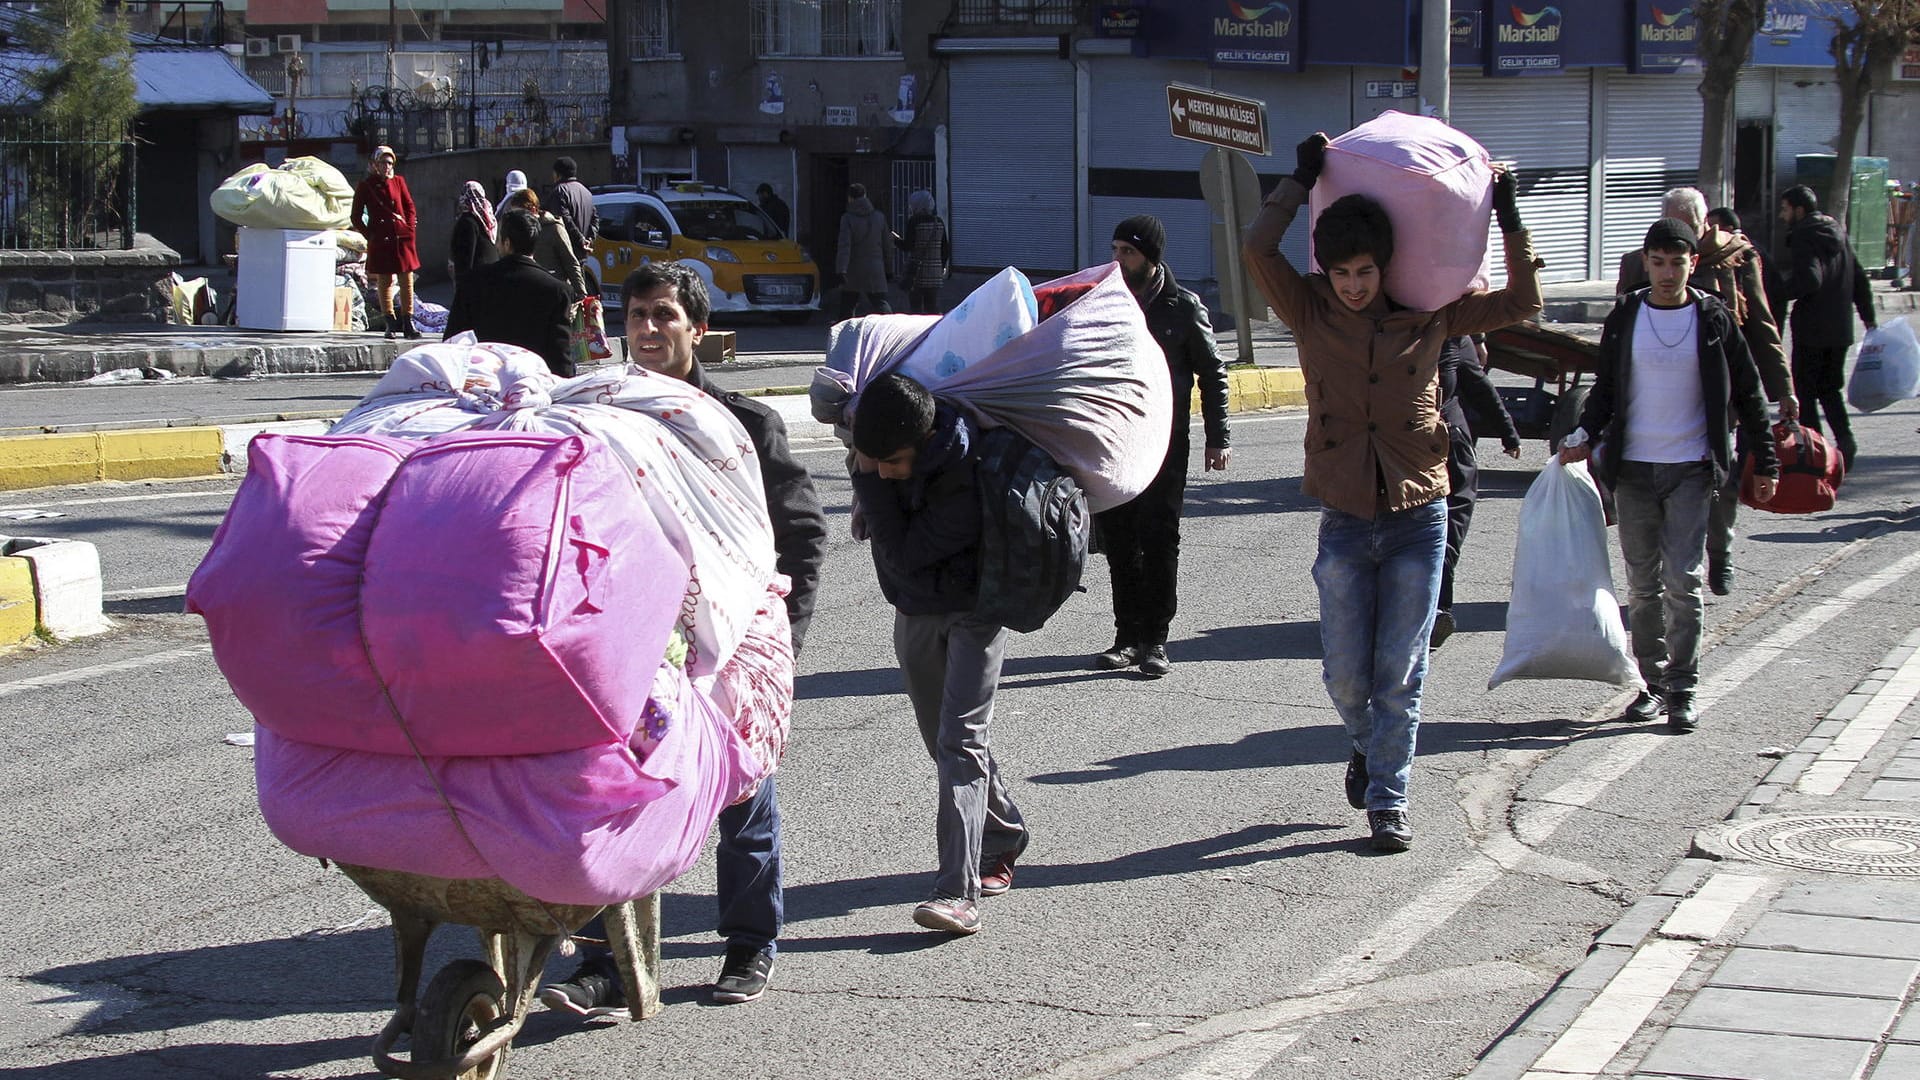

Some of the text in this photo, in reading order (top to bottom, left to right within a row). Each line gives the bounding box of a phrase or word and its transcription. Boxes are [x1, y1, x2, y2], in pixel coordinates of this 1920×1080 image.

[1214, 17, 1284, 37] Marshall
[1499, 24, 1557, 42] Marshall
[1641, 24, 1694, 41] Marshall
[1216, 51, 1286, 61] ÇELİK TİCARET
[1188, 98, 1257, 125] MERYEM ANA KİLİSESİ
[1188, 118, 1260, 147] (VIRGIN MARY CHURCH)
